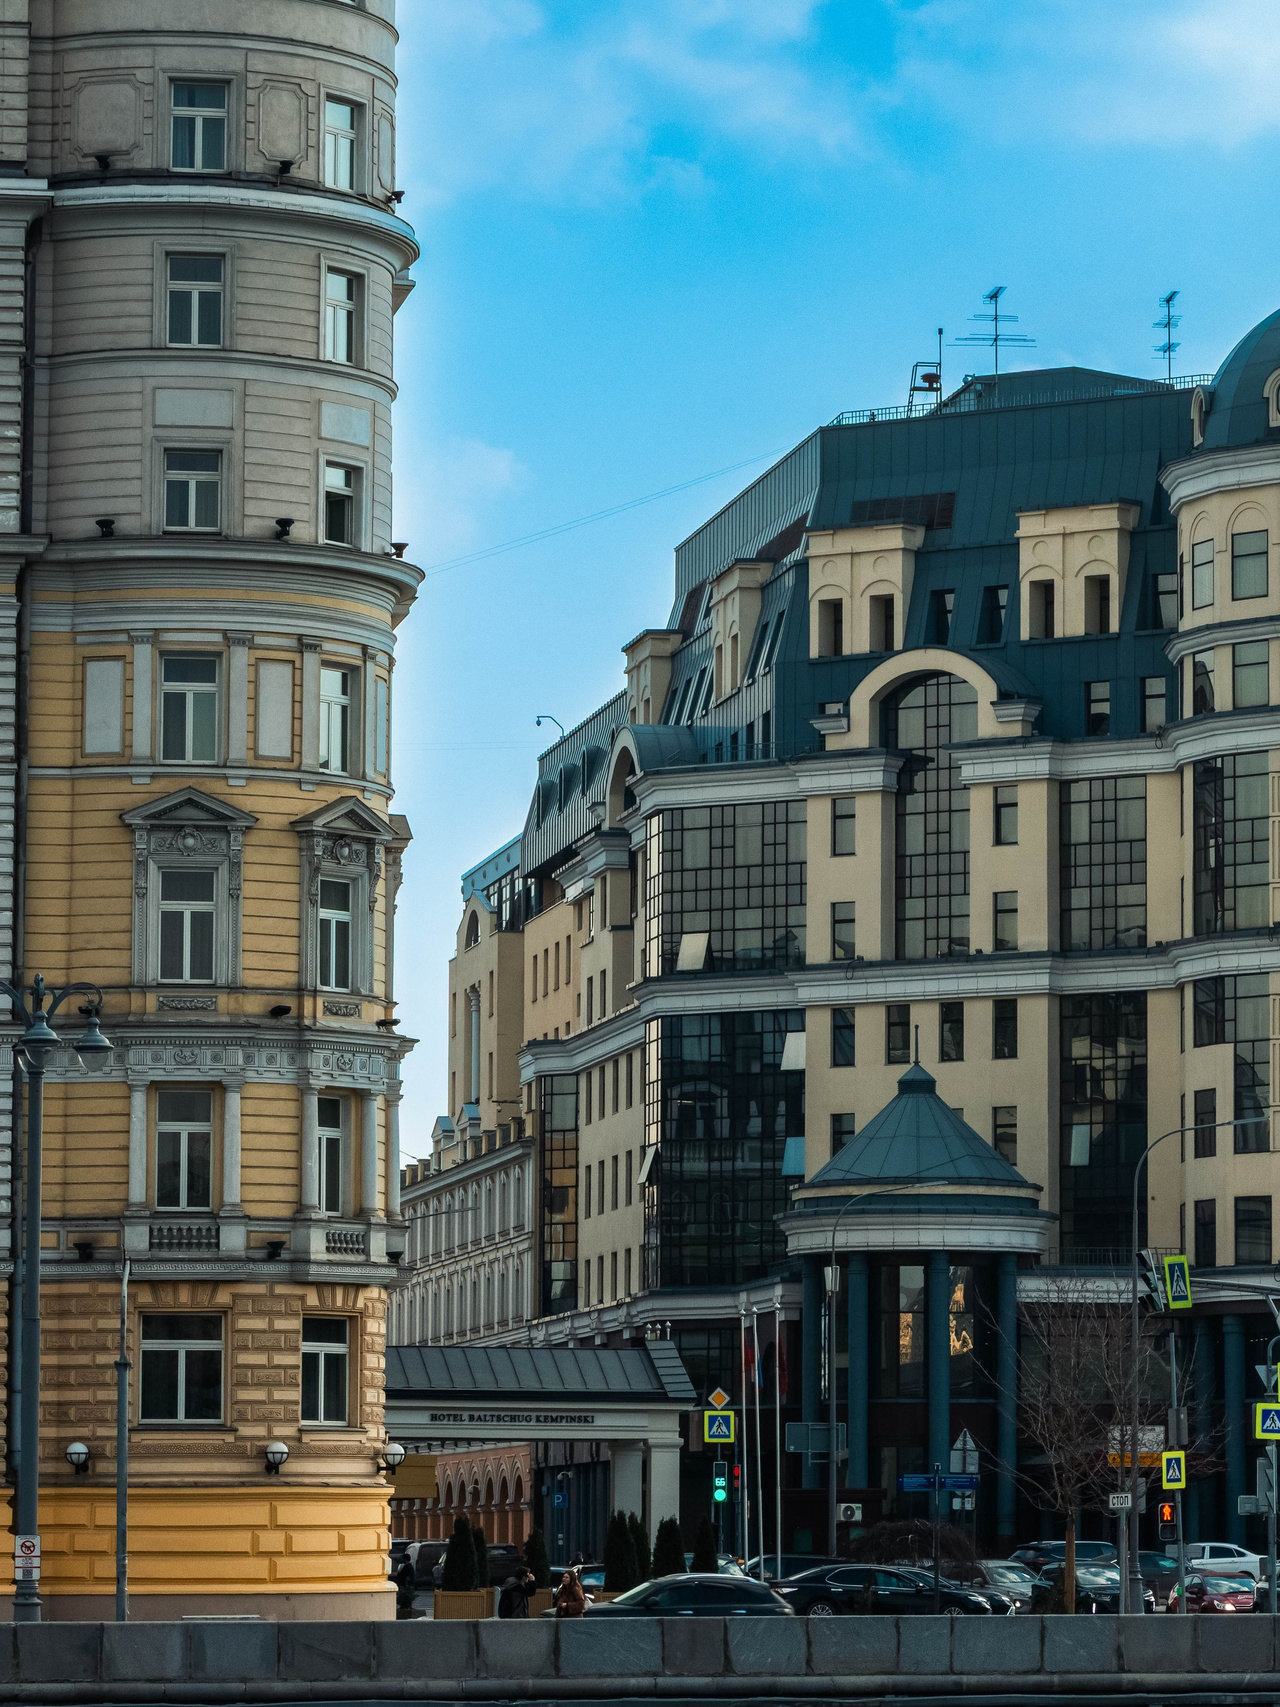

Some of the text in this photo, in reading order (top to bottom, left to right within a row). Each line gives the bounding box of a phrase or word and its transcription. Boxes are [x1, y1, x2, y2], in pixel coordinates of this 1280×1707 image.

[430, 1413, 595, 1424] HOTEL BALTSCHUG KEMPINSKI
[715, 1477, 726, 1486] 66
[554, 1494, 563, 1507] P
[1111, 1495, 1129, 1507] СТОП
